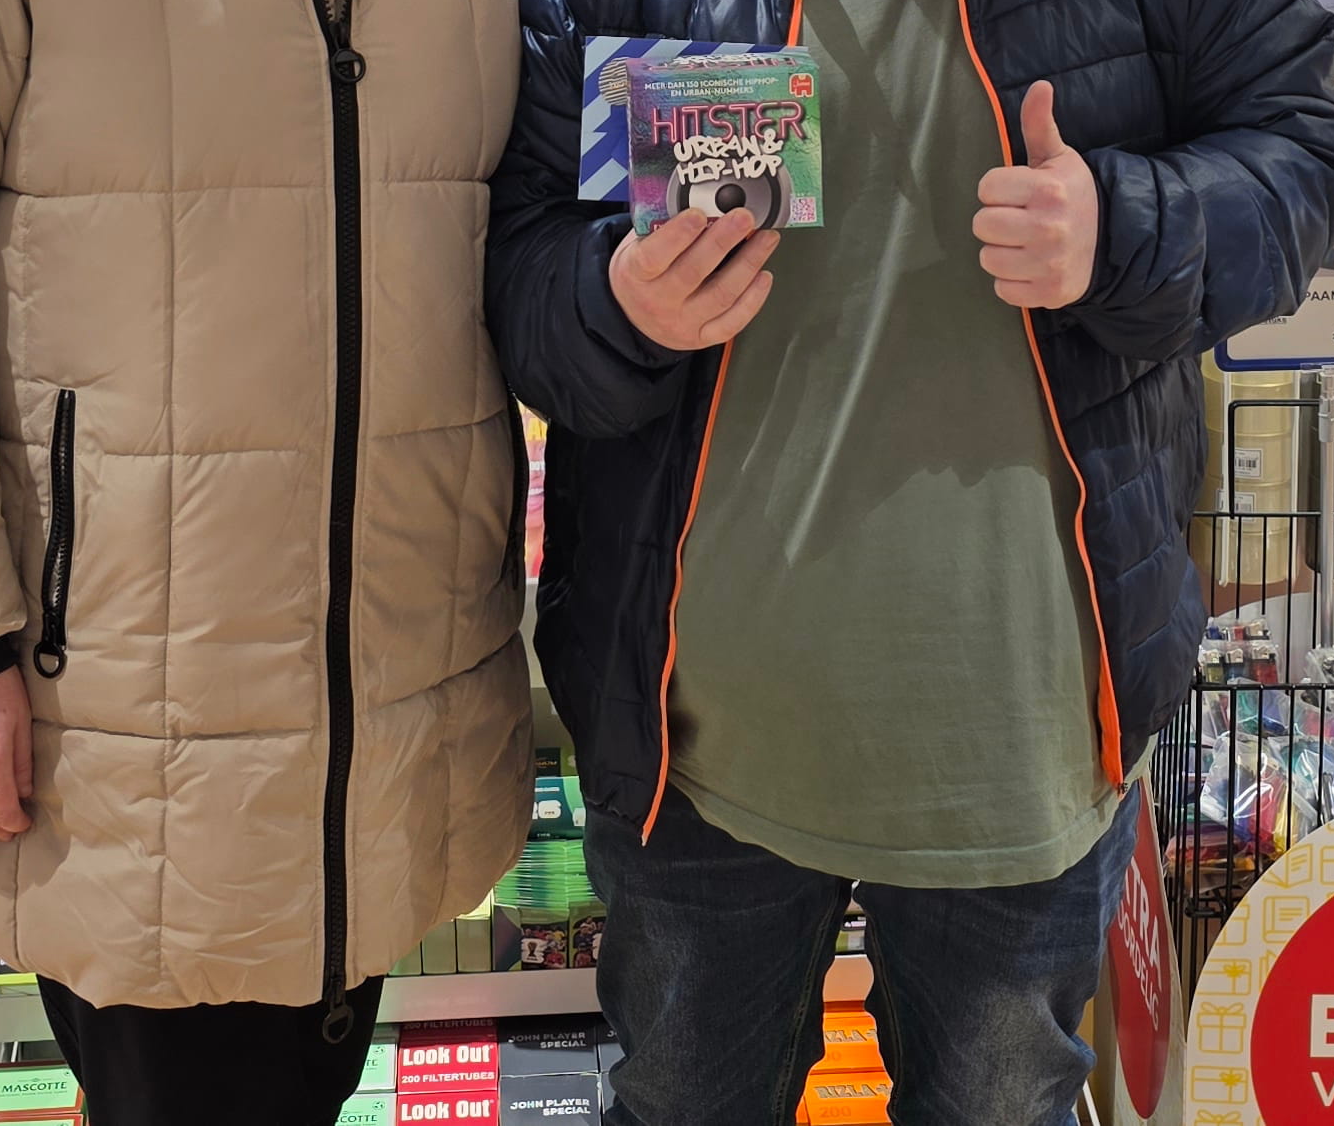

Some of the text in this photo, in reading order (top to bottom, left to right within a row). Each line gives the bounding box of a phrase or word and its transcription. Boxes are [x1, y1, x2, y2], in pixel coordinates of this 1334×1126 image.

[651, 101, 805, 145] HITSTER
[674, 128, 783, 162] URBAN &
[677, 155, 782, 185] HIP-HOP
[423, 1018, 494, 1028] FILTERTUBES
[508, 1032, 586, 1043] JOHN PLAYER
[540, 1040, 586, 1049] SPECIAL
[402, 1045, 490, 1066] Look Out
[401, 1071, 495, 1084] 200 FILTERTUBES
[2, 1081, 67, 1093] MASCOTTE
[510, 1098, 590, 1110] JOHN PLAYER
[401, 1100, 490, 1122] Look Out
[542, 1107, 591, 1116] SPECIAL
